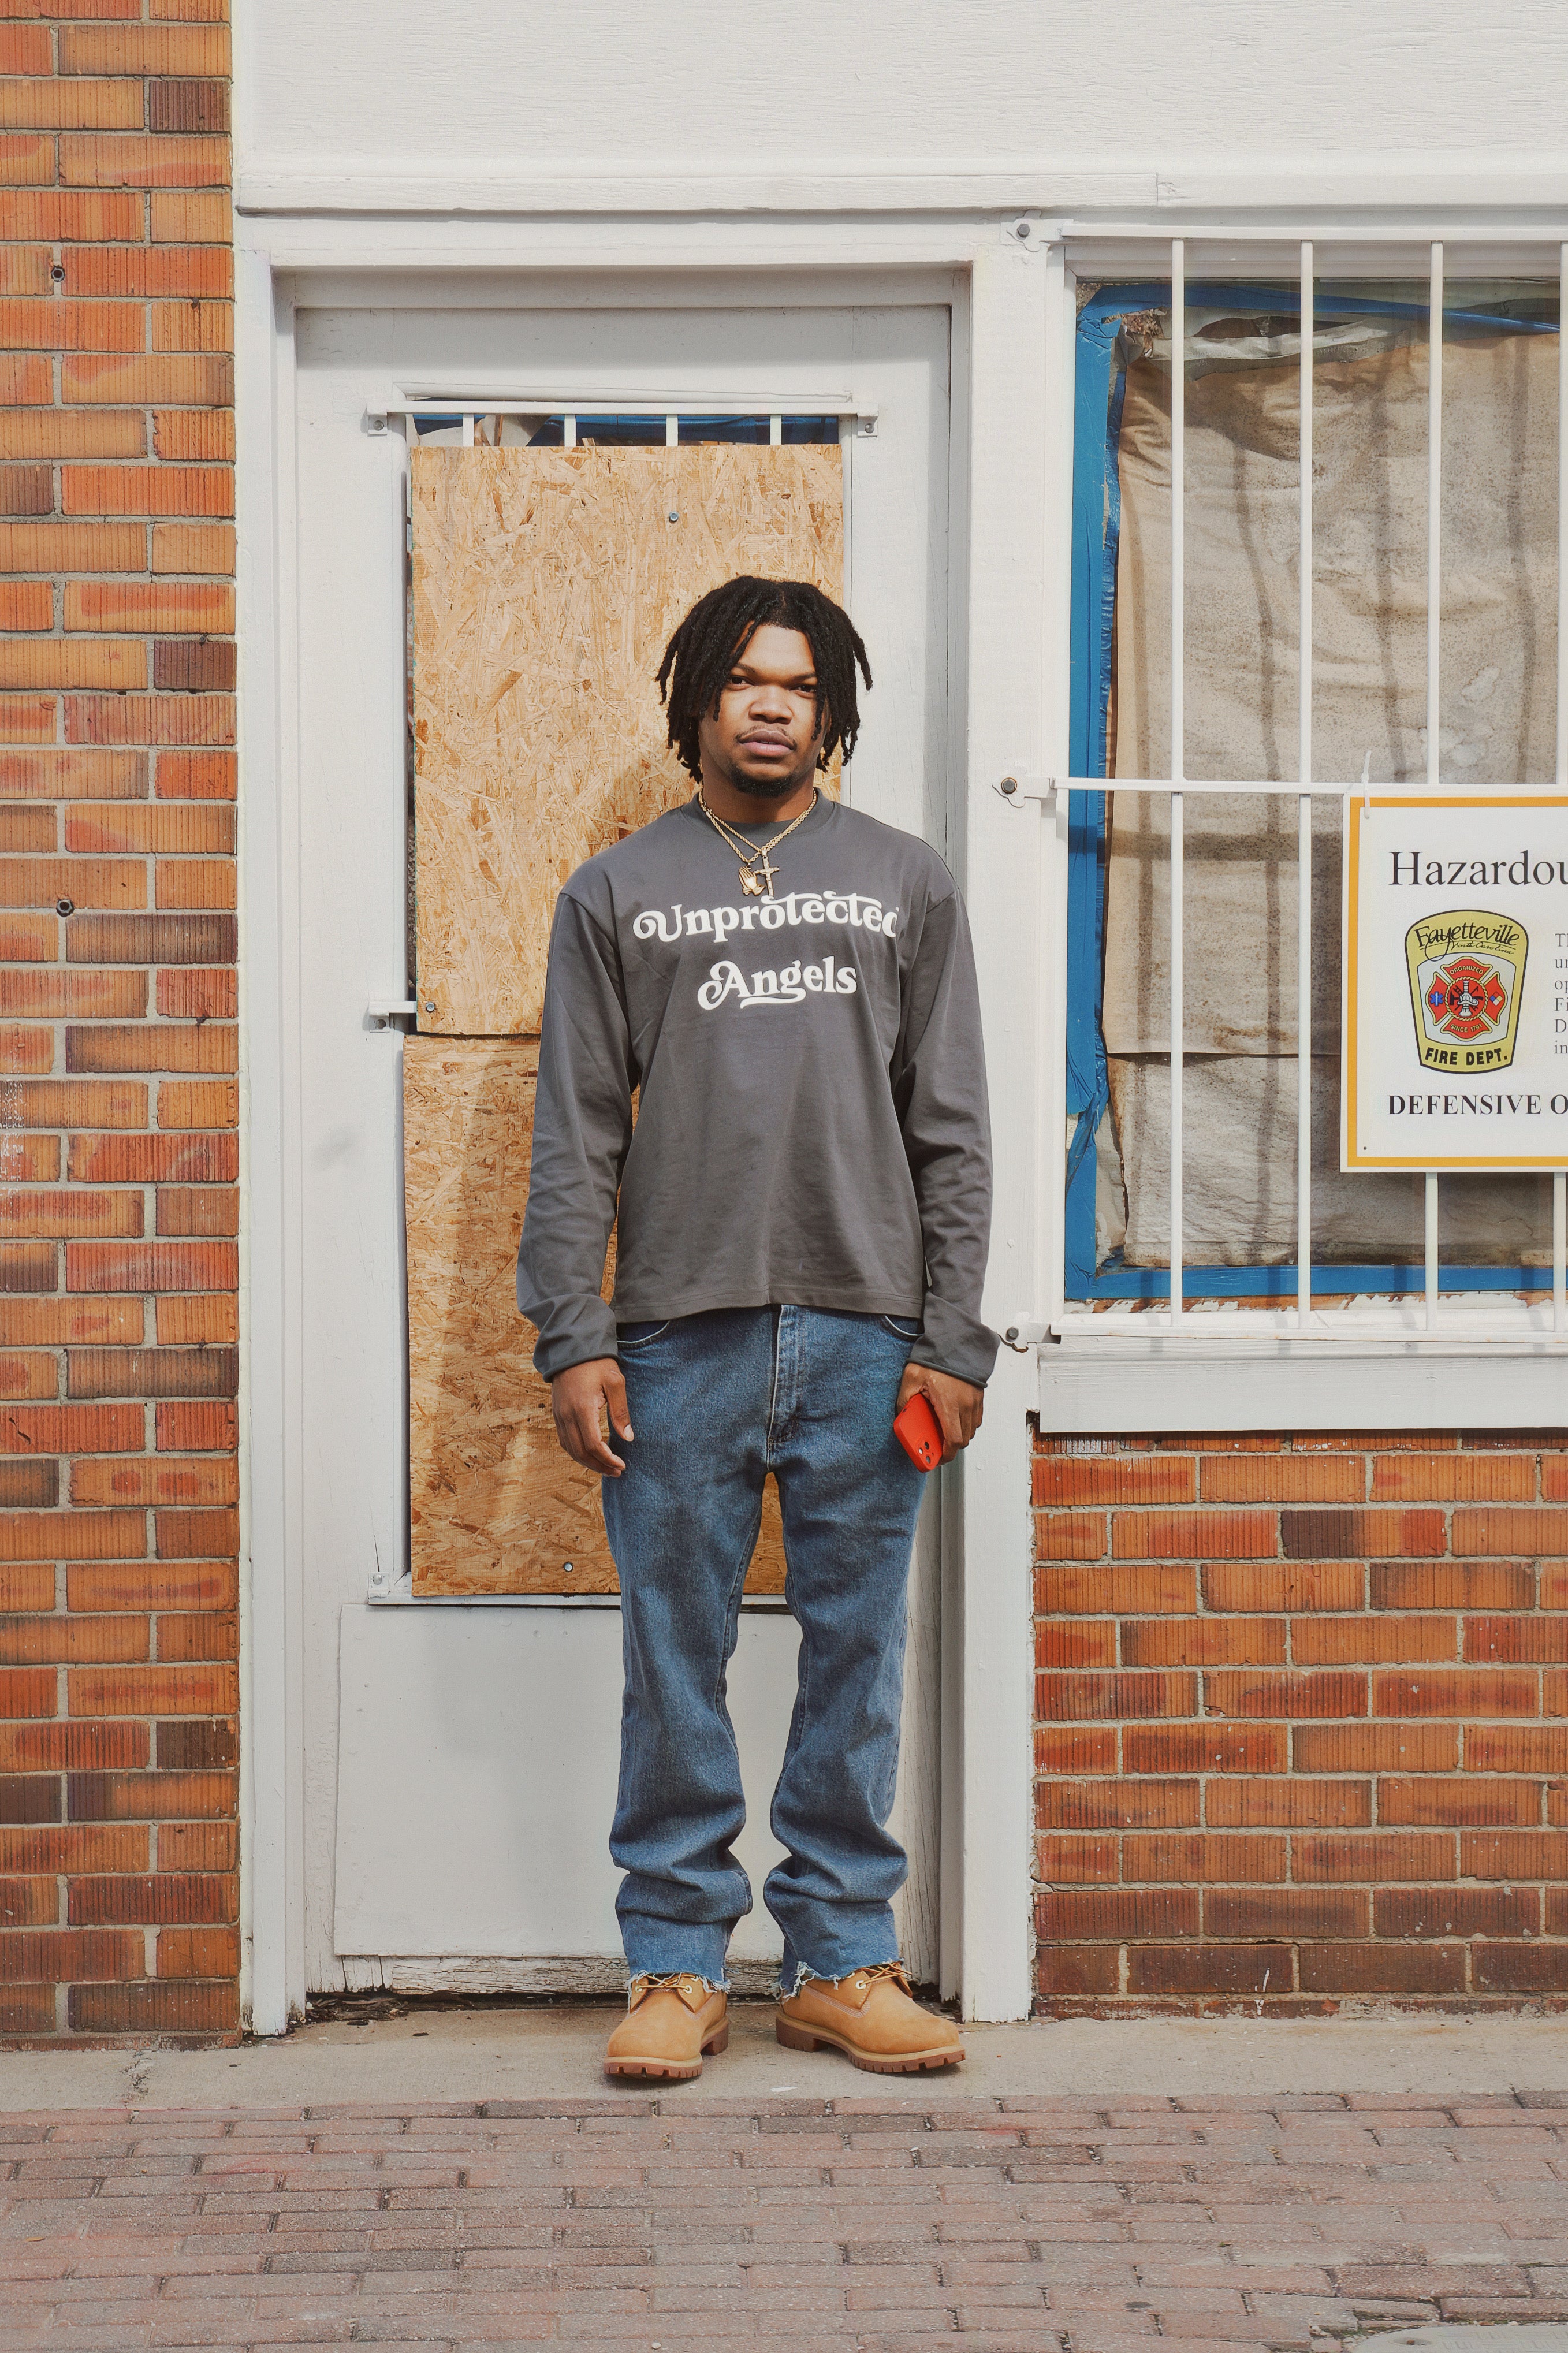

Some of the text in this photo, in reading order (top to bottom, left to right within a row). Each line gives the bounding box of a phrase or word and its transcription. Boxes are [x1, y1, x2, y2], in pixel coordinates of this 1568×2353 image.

[1414, 922, 1520, 962] Fayetteville
[1554, 933, 1568, 948] T
[1450, 965, 1483, 974] ORGANIZED
[697, 956, 857, 1010] Angels
[1450, 1023, 1483, 1033] SINCE 1791
[1425, 1047, 1507, 1066] FIRE DEPT.
[1387, 1095, 1541, 1115] DEFENSIVE
